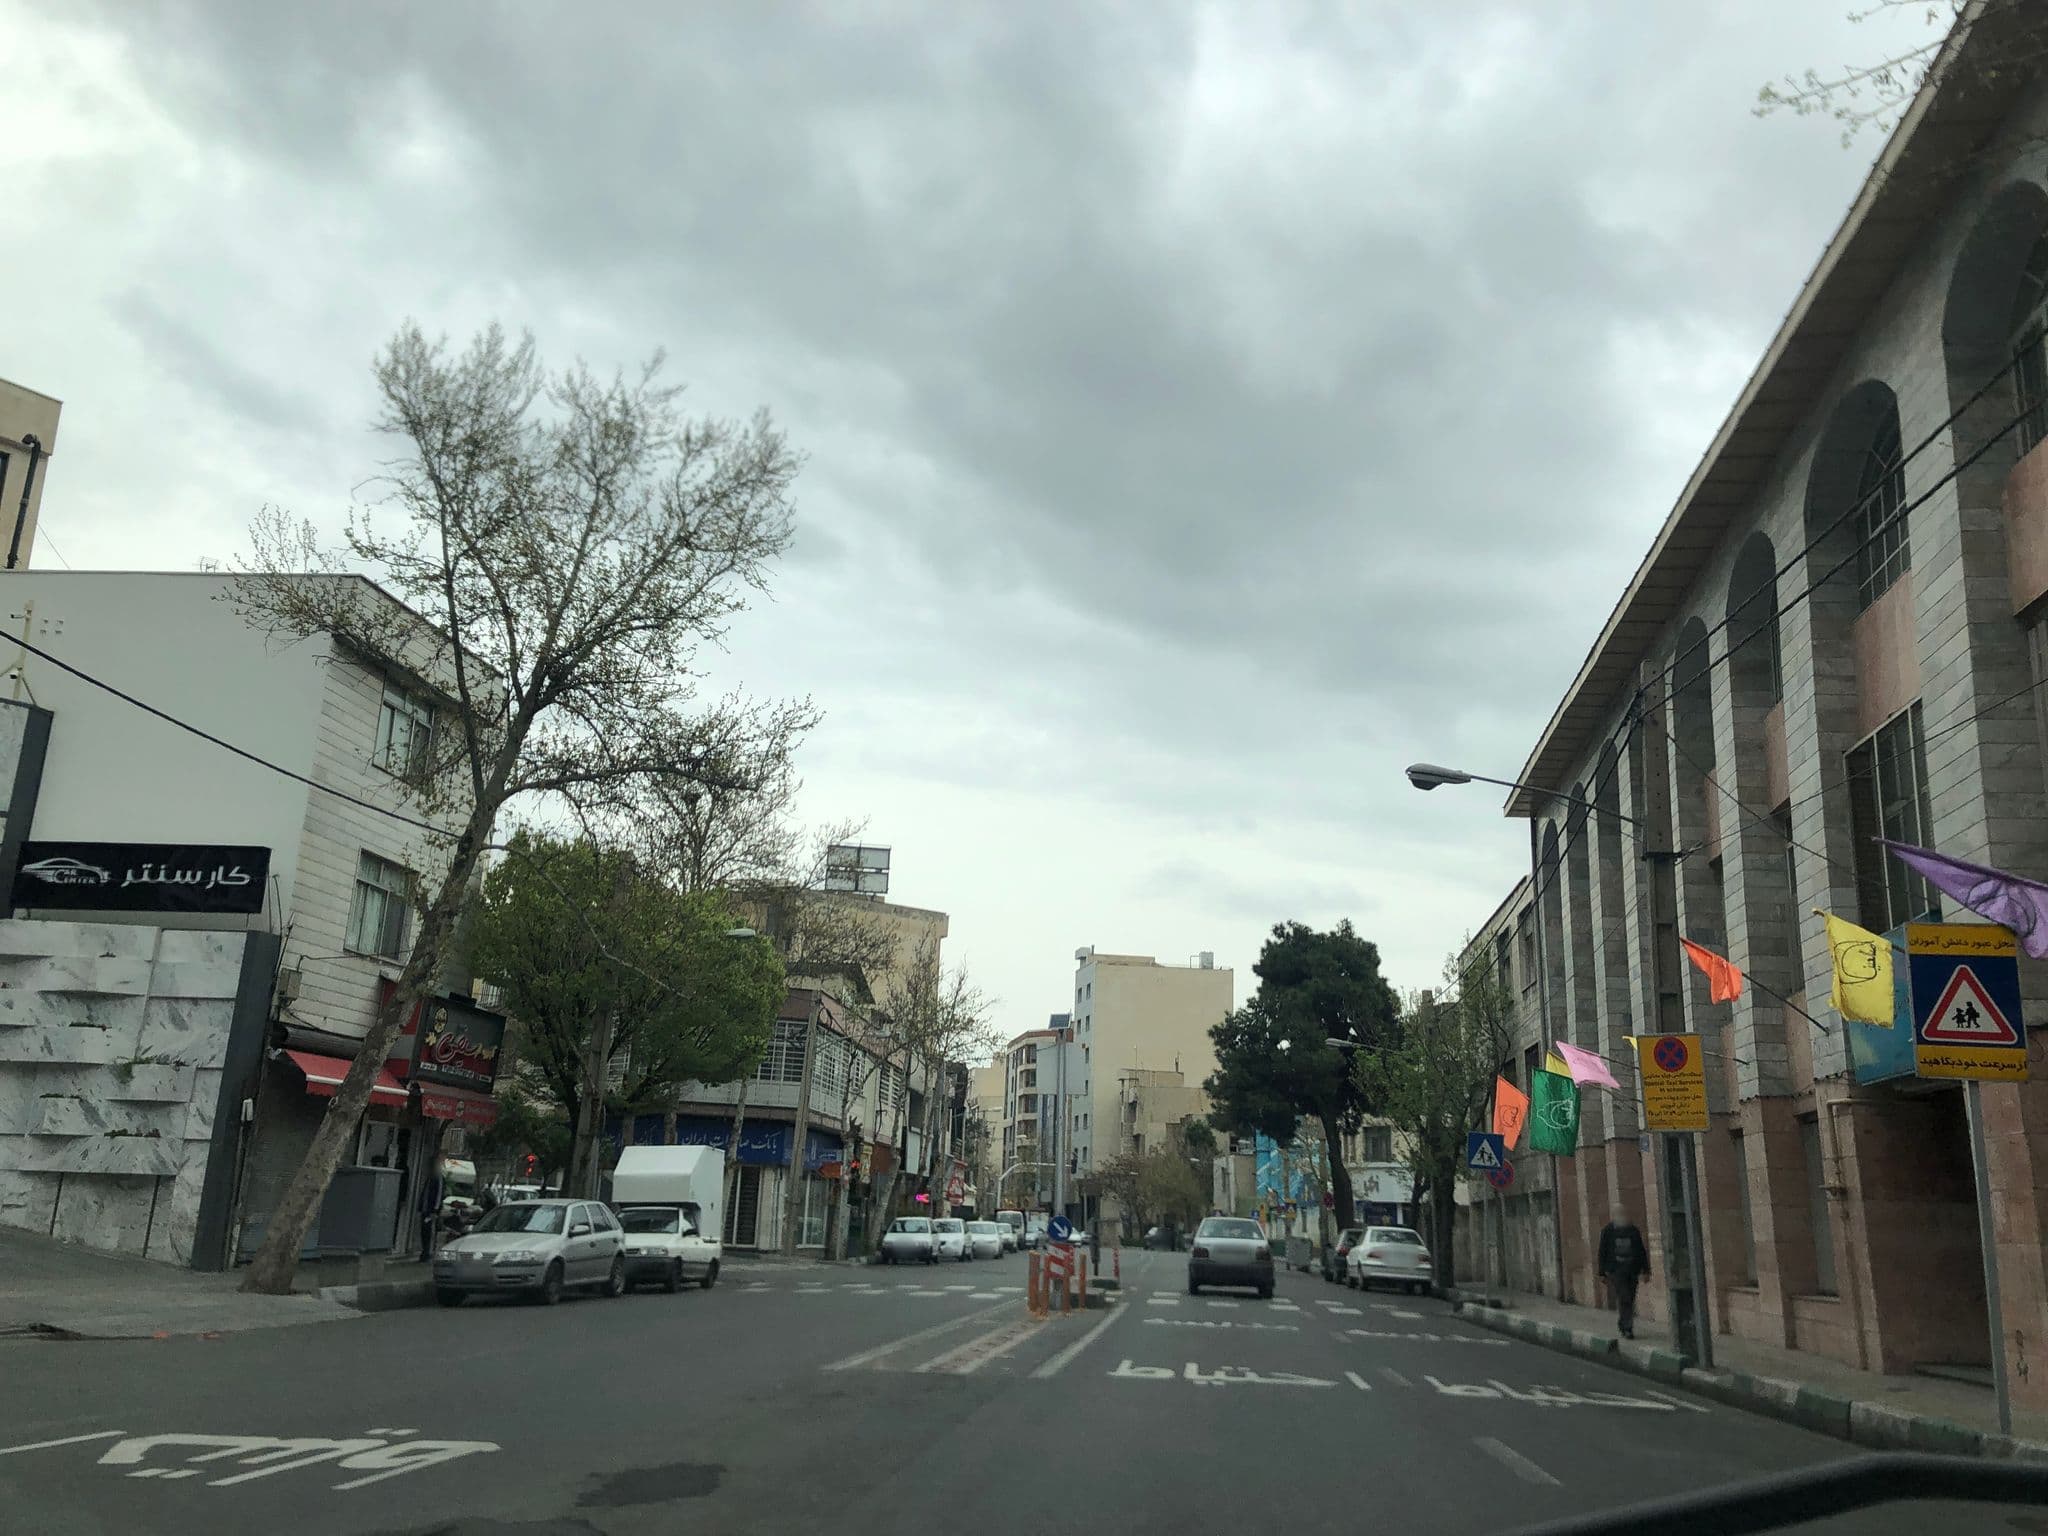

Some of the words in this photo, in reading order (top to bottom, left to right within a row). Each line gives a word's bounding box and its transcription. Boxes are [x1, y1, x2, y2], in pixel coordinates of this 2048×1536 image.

[120, 863, 202, 888] سنتر
[205, 864, 250, 889] کار
[1909, 936, 1939, 948] آموزان
[1941, 938, 1968, 949] دانش
[1971, 940, 1991, 949] عبور
[1993, 938, 2016, 950] محل
[1920, 1056, 1955, 1068] بکاهید
[1954, 1058, 1977, 1070] خود
[1980, 1058, 2016, 1072] سرعت
[681, 1132, 707, 1146] ایران
[709, 1134, 750, 1147] صاات
[751, 1131, 782, 1154] بانک
[1107, 1360, 1372, 1391] احتیاط
[1424, 1375, 1710, 1413] احتیاط
